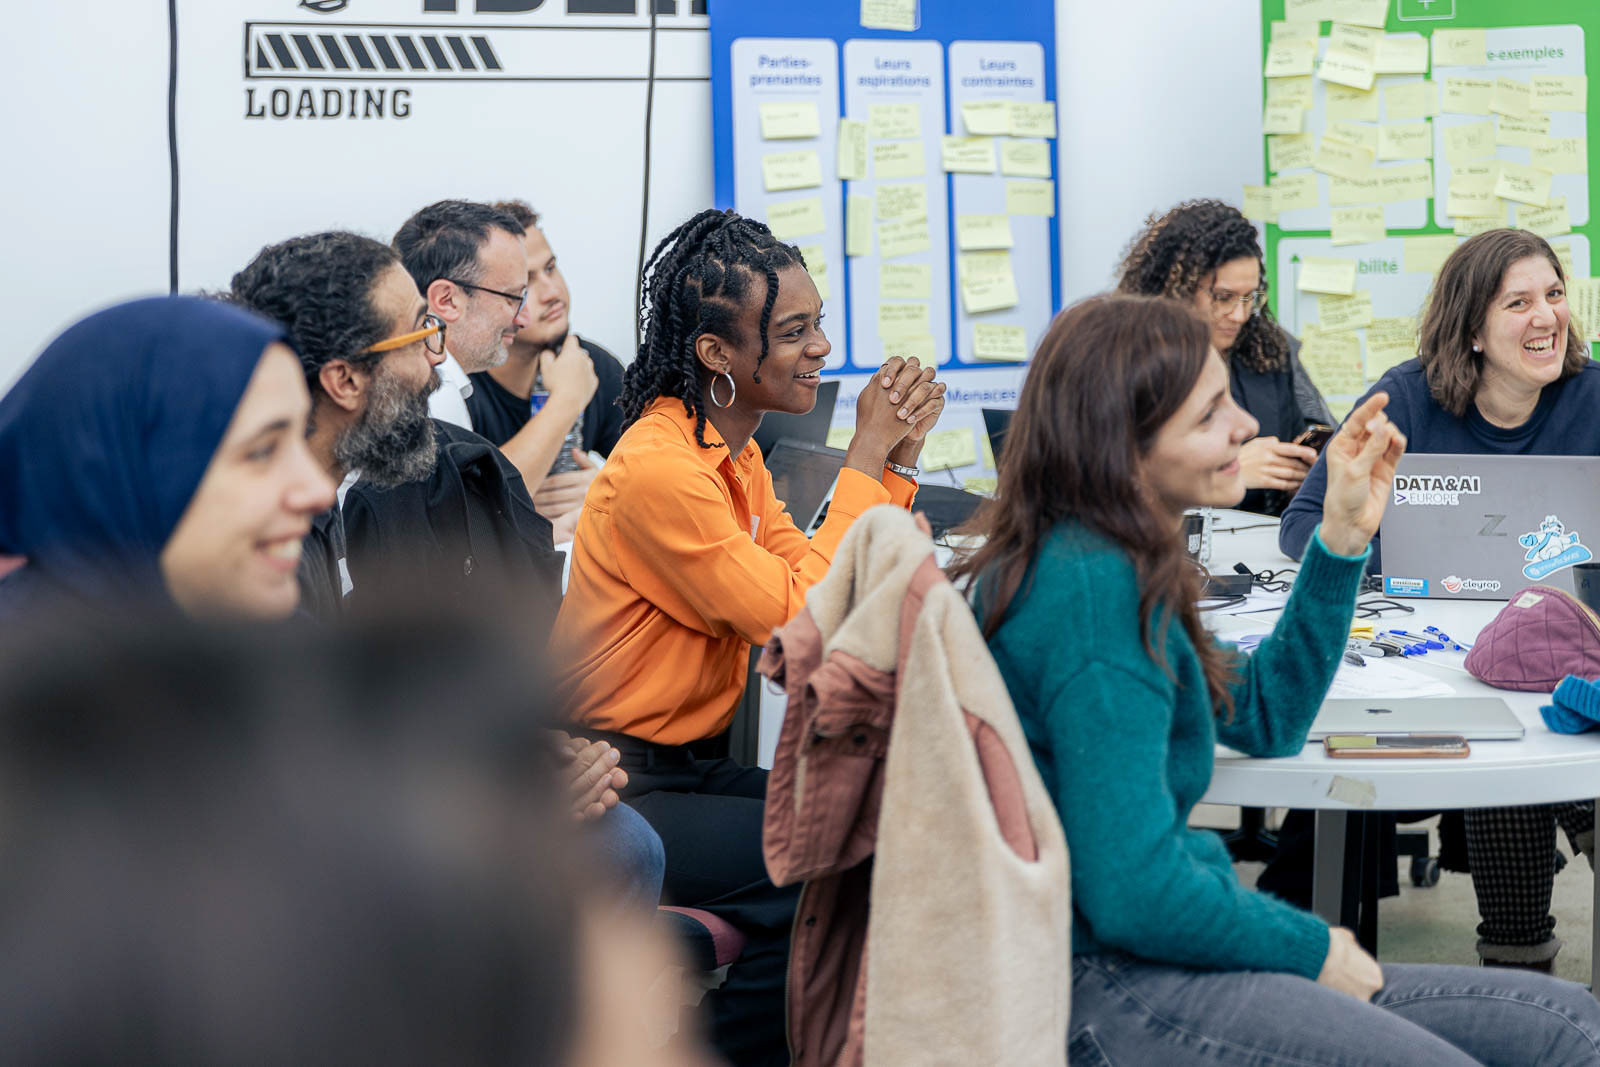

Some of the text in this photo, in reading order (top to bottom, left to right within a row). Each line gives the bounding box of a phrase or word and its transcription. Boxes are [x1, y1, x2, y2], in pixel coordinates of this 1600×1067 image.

[758, 55, 812, 69] Parties-
[875, 56, 911, 70] Leurs
[980, 58, 1017, 71] Leurs
[857, 75, 931, 88] aspirations
[961, 76, 1035, 88] contraintes
[245, 88, 412, 118] LOADING
[1395, 478, 1479, 492] DATA&AI
[1409, 494, 1458, 505] EUROPE
